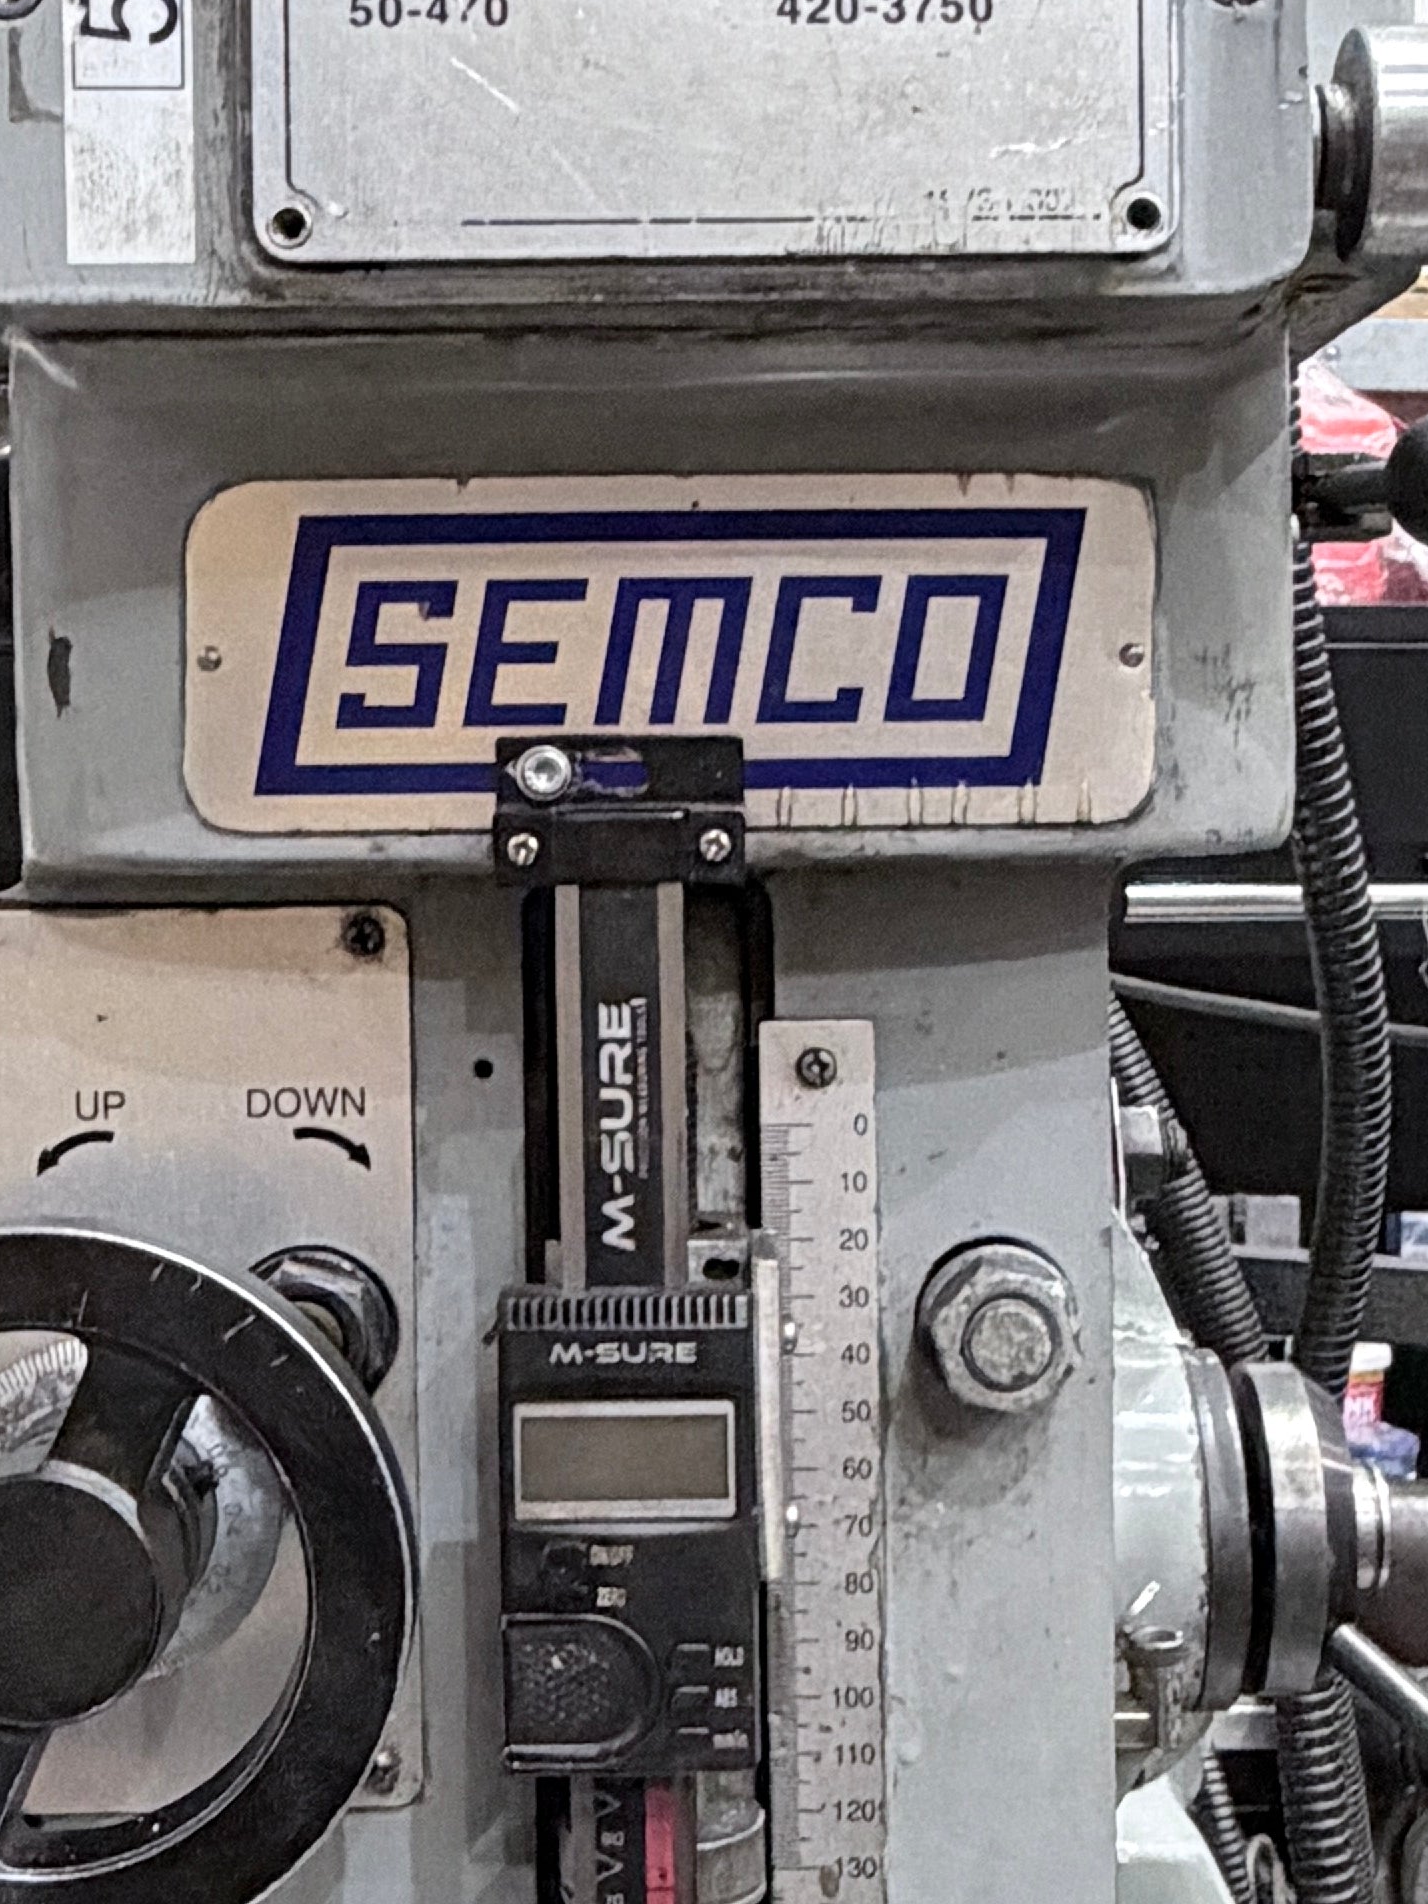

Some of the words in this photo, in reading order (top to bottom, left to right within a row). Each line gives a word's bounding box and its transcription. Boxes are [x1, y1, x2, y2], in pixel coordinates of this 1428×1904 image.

[335, 574, 1011, 730] SEMCO
[75, 1090, 126, 1121] UP
[245, 1087, 367, 1119] DOWN
[597, 999, 636, 1252] M-SURE
[853, 1113, 869, 1136] 0
[840, 1171, 869, 1193] 10
[838, 1228, 870, 1251] 20
[838, 1285, 870, 1309] 30
[548, 1341, 698, 1365] M-SURE
[840, 1343, 871, 1366] 40
[841, 1400, 872, 1424] 50
[842, 1457, 873, 1480] 60
[843, 1514, 873, 1537] 70
[844, 1571, 874, 1594] 80
[844, 1629, 875, 1652] 90
[832, 1686, 875, 1709] 100
[835, 1743, 876, 1765] 110
[832, 1799, 877, 1823] 120
[834, 1856, 878, 1879] 130
